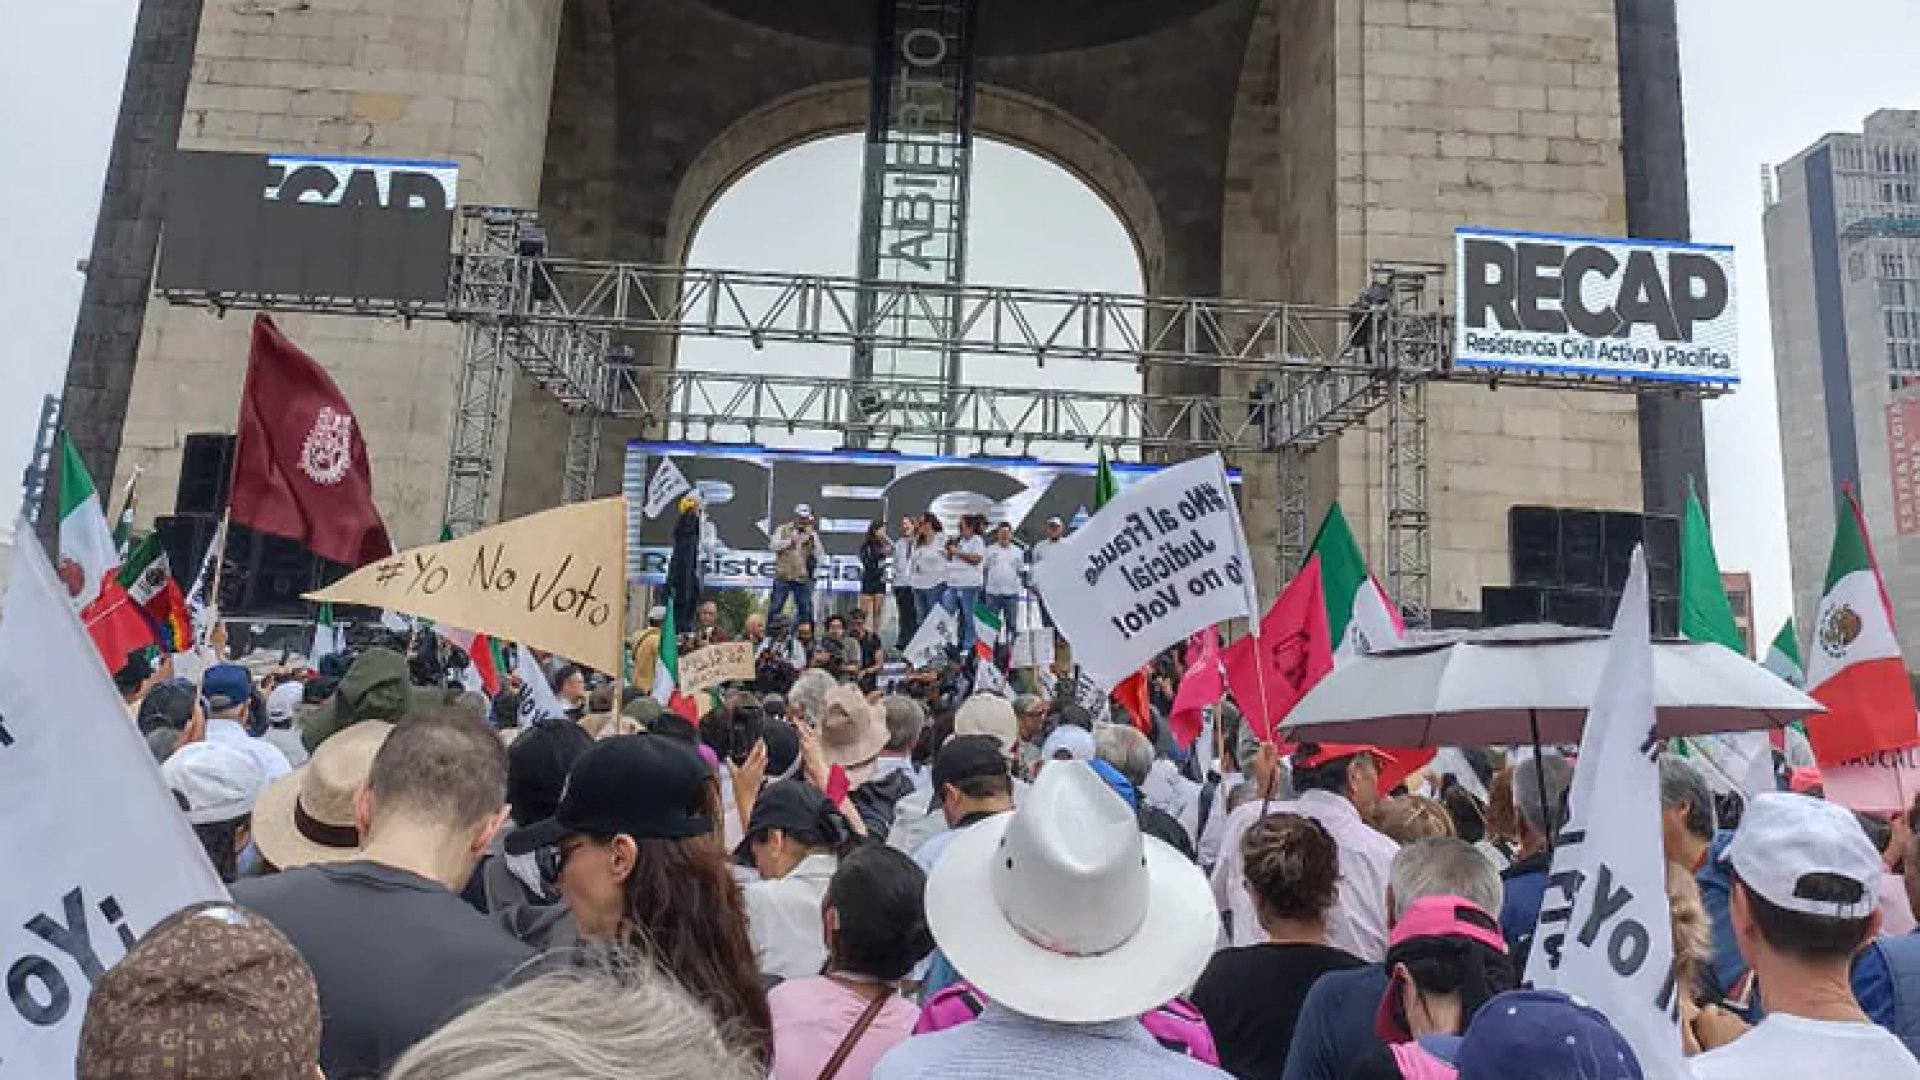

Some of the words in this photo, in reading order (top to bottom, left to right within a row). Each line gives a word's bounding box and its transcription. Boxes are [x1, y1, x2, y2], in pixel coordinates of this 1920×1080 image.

[890, 28, 946, 271] ABIERTO
[1464, 240, 1728, 343] RECAP
[1466, 332, 1557, 357] Resistencia
[1561, 337, 1595, 359] Civil
[1597, 342, 1650, 364] Activa
[1650, 350, 1662, 369] y
[376, 552, 449, 596] #Yo
[467, 542, 517, 592] No
[528, 553, 611, 627] Voto
[1577, 862, 1650, 977] Yo
